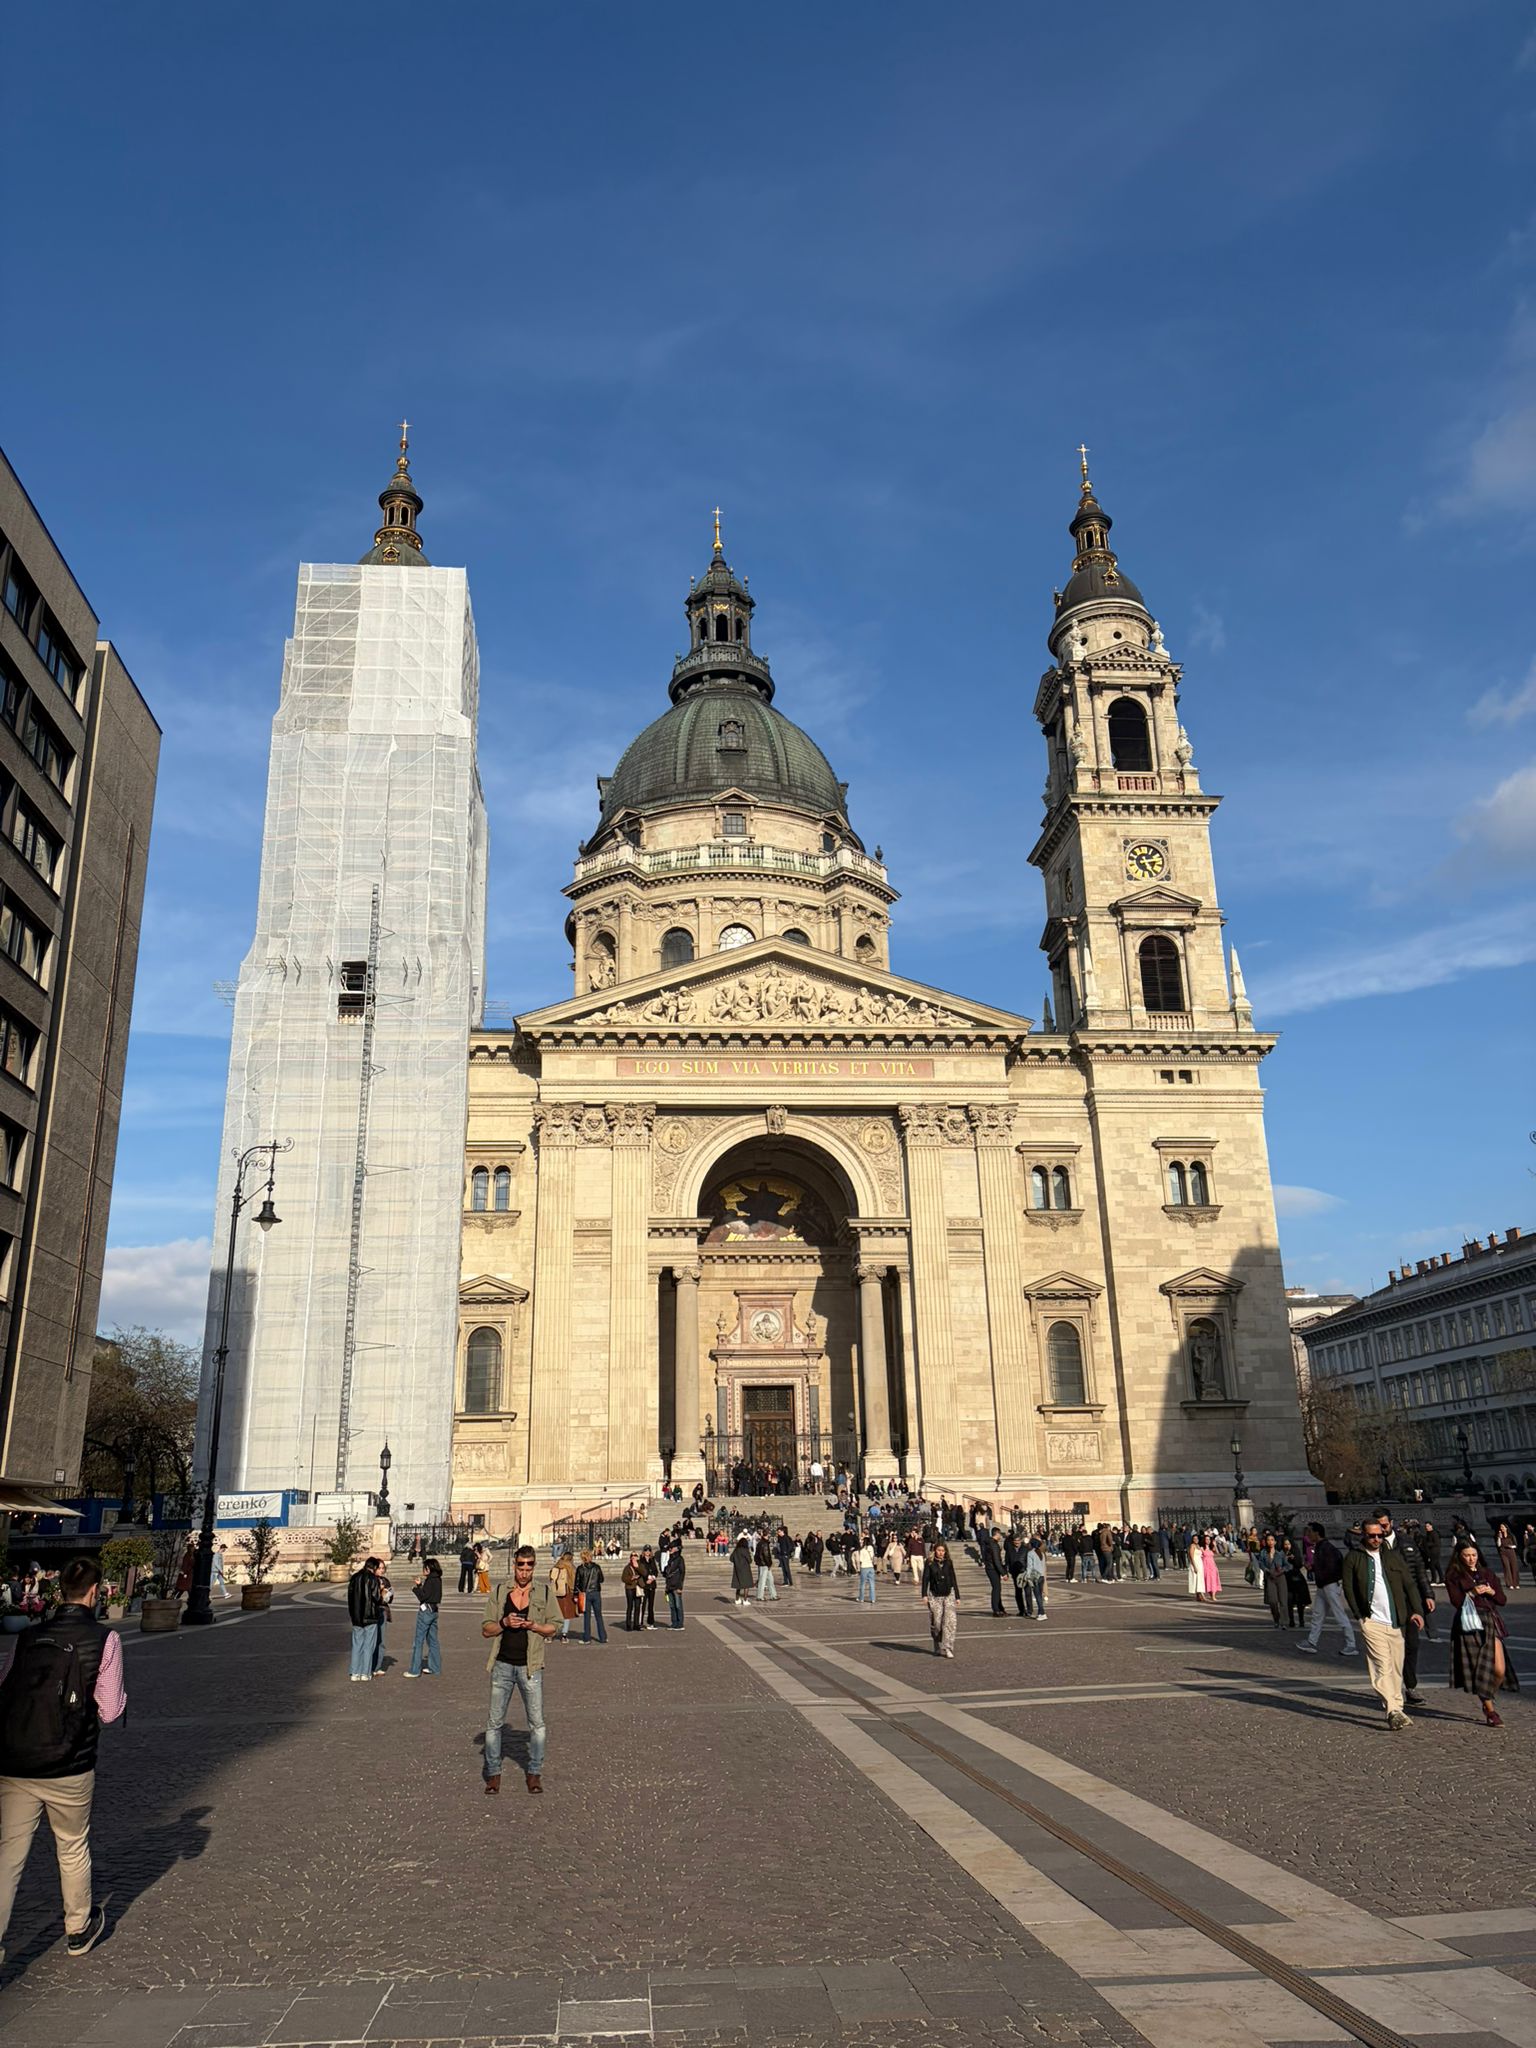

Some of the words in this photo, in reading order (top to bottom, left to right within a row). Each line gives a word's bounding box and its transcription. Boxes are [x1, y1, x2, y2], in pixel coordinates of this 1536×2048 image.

[635, 1061, 670, 1074] EGO
[682, 1062, 718, 1074] SUM
[732, 1062, 761, 1074] VIA
[771, 1062, 840, 1075] VERITAS
[850, 1062, 870, 1075] ET
[880, 1062, 916, 1075] VITA
[218, 1496, 267, 1511] erenkó
